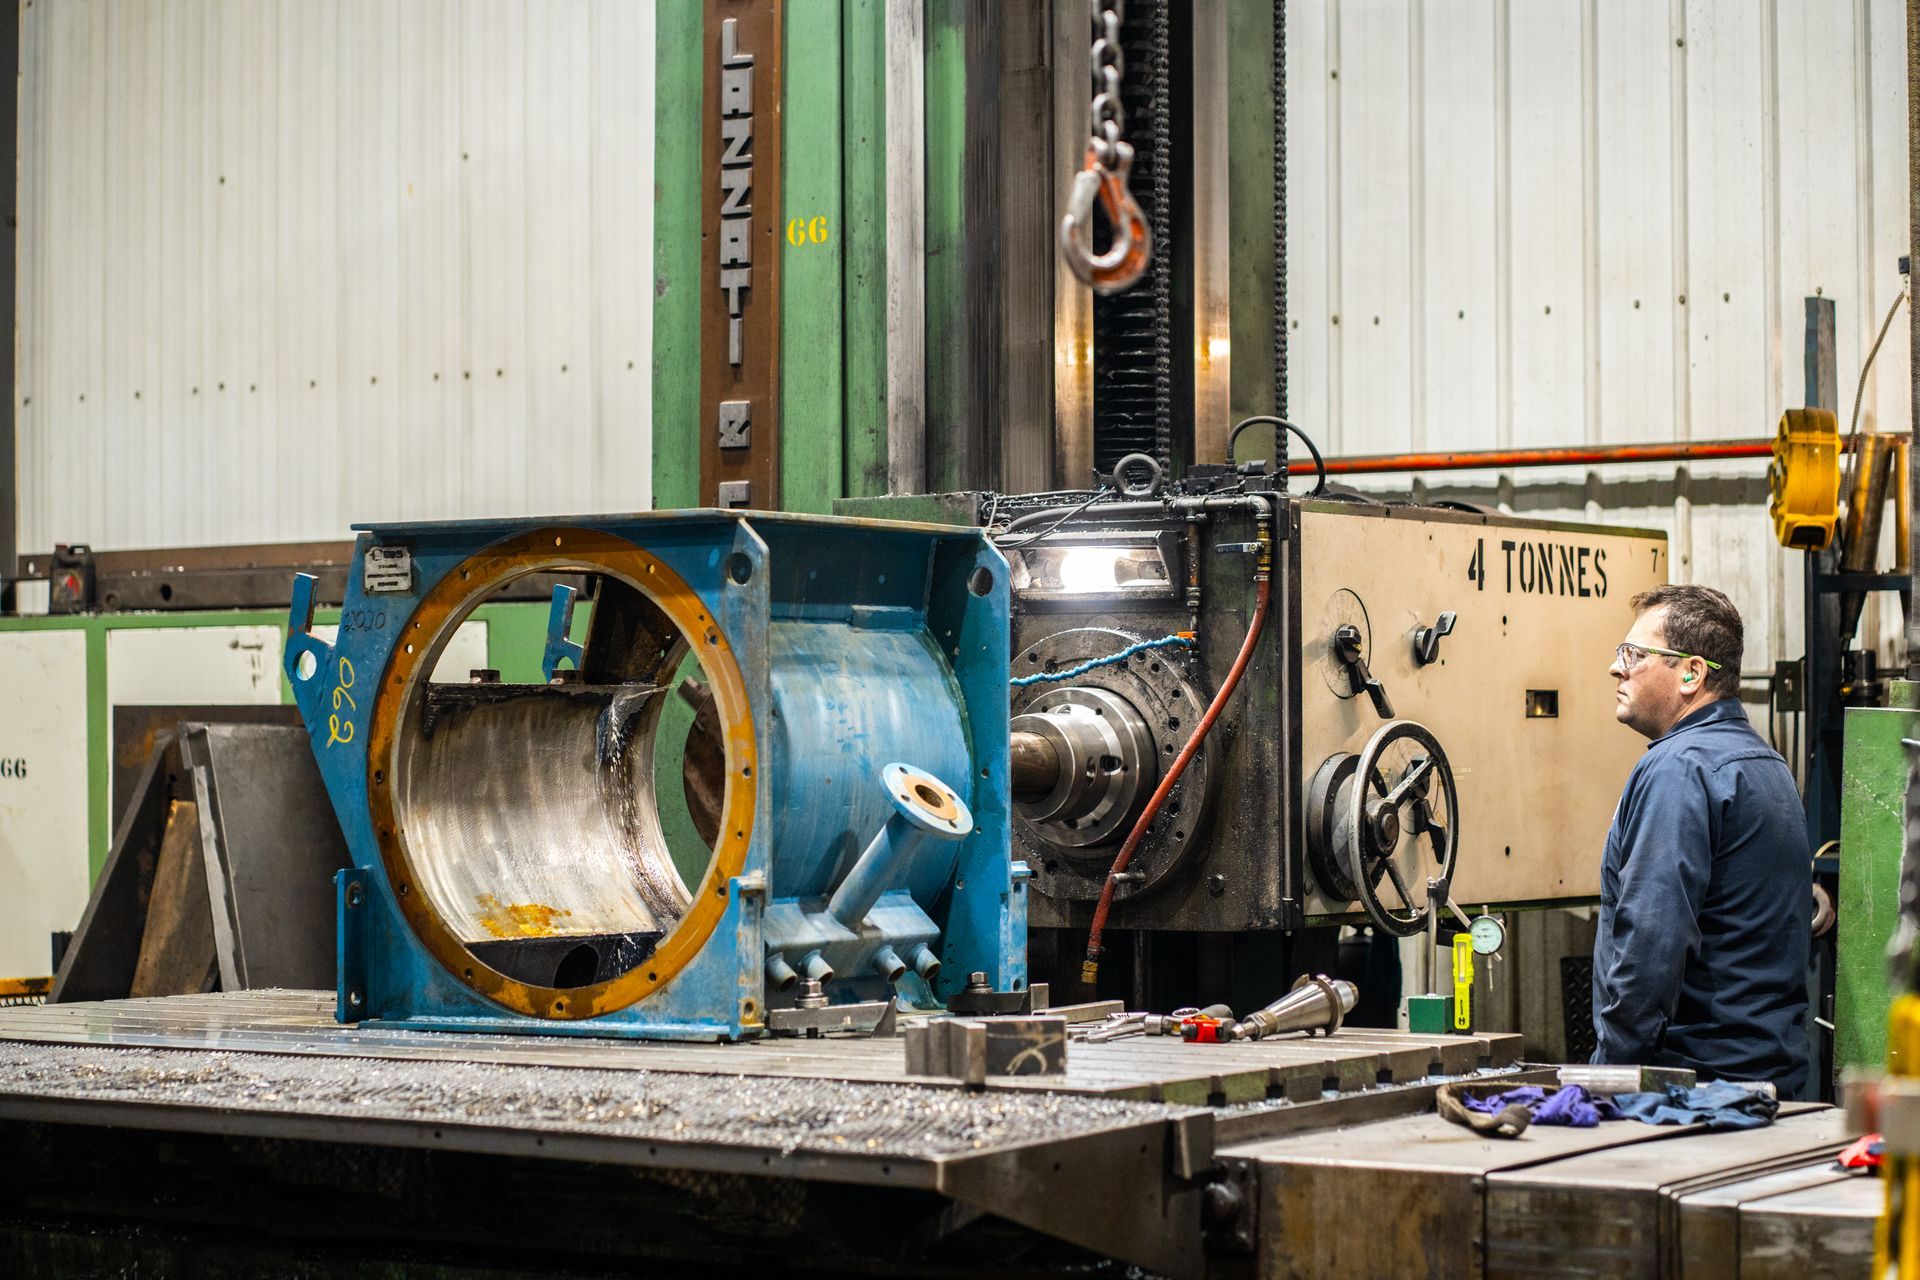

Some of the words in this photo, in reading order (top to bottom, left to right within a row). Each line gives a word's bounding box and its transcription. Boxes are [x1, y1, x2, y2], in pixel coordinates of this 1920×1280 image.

[720, 18, 754, 367] LAZZATI
[787, 215, 829, 249] 66
[1467, 538, 1485, 591] 4
[1501, 540, 1607, 598] TONNES
[344, 610, 386, 632] 2020
[0, 757, 27, 779] 66
